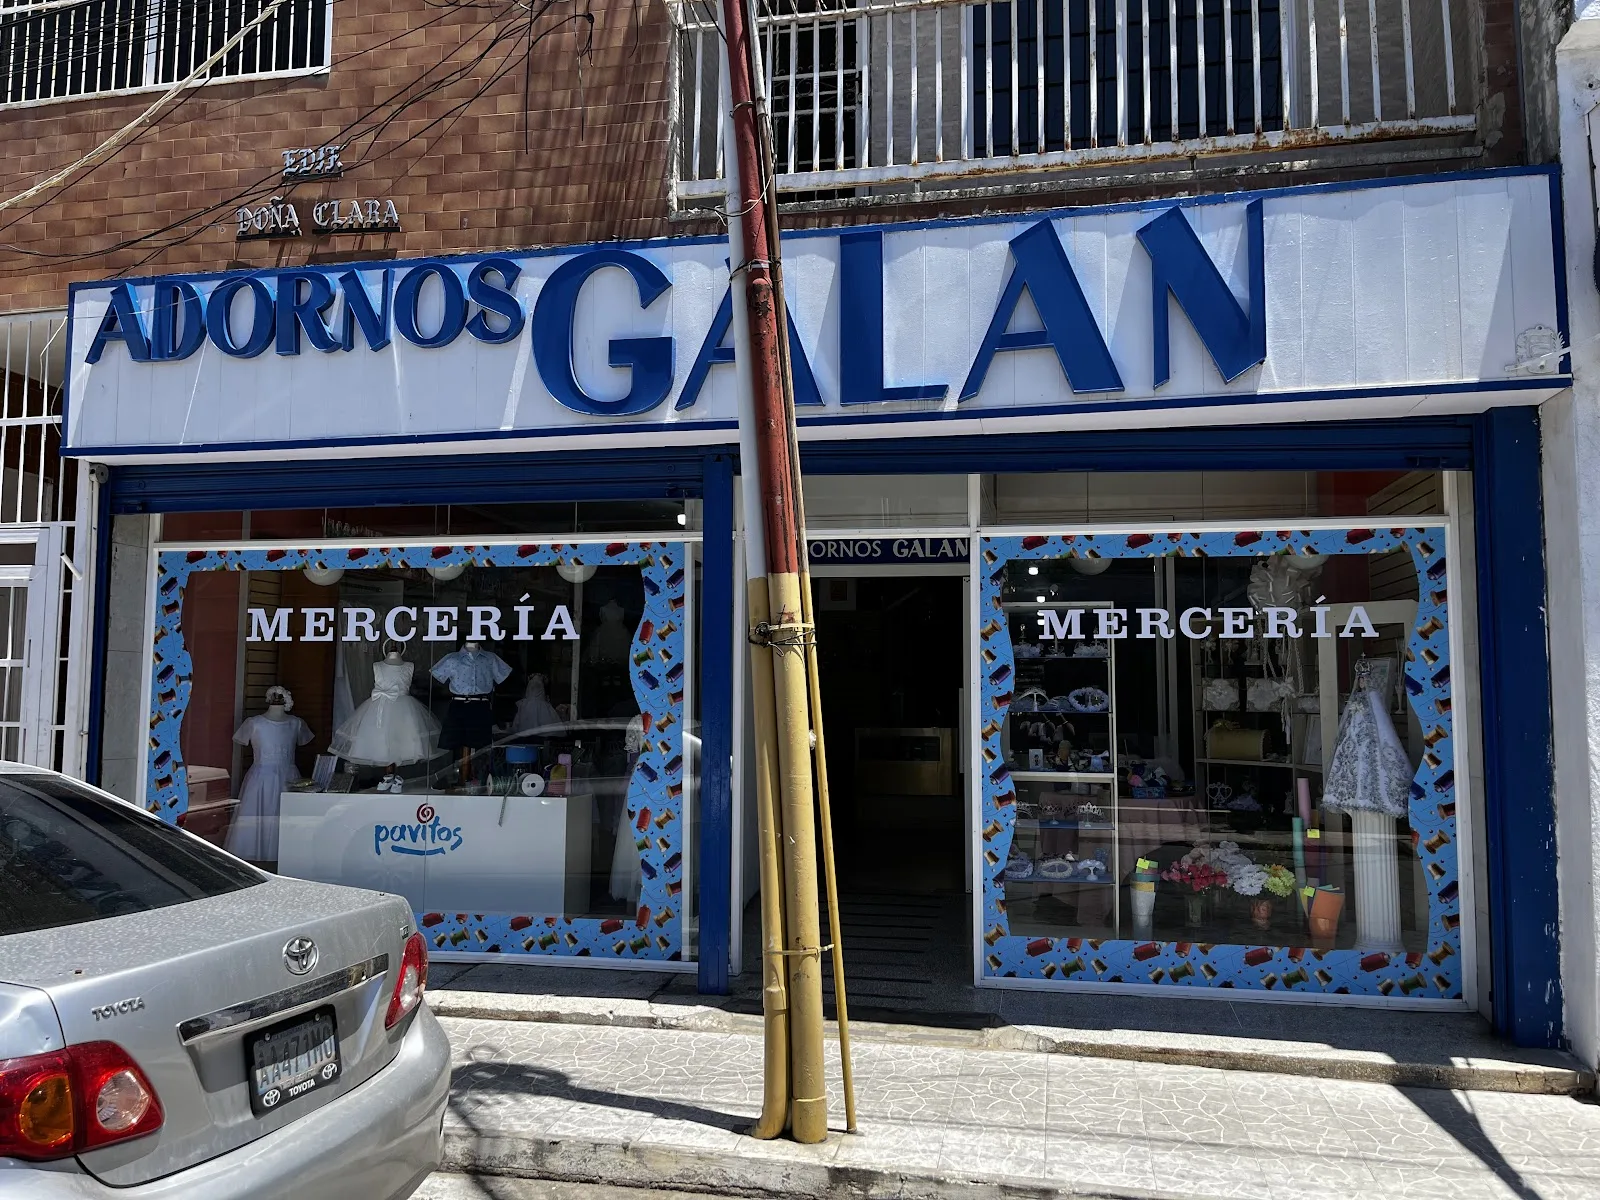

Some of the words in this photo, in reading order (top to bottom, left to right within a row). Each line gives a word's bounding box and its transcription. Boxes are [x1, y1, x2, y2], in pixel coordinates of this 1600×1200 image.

[236, 195, 300, 235] DOÑA
[312, 199, 399, 228] CLARA
[84, 257, 526, 364] ADORNOS
[531, 199, 1267, 416] GALAN
[808, 540, 882, 558] ORNOS
[892, 538, 968, 558] GALAN
[246, 592, 580, 642] MERCERÍA
[1038, 594, 1380, 640] MERCERÍA
[374, 803, 463, 855] pavitos
[91, 997, 145, 1022] TOYOTA
[288, 1079, 316, 1097] TOYOTA
